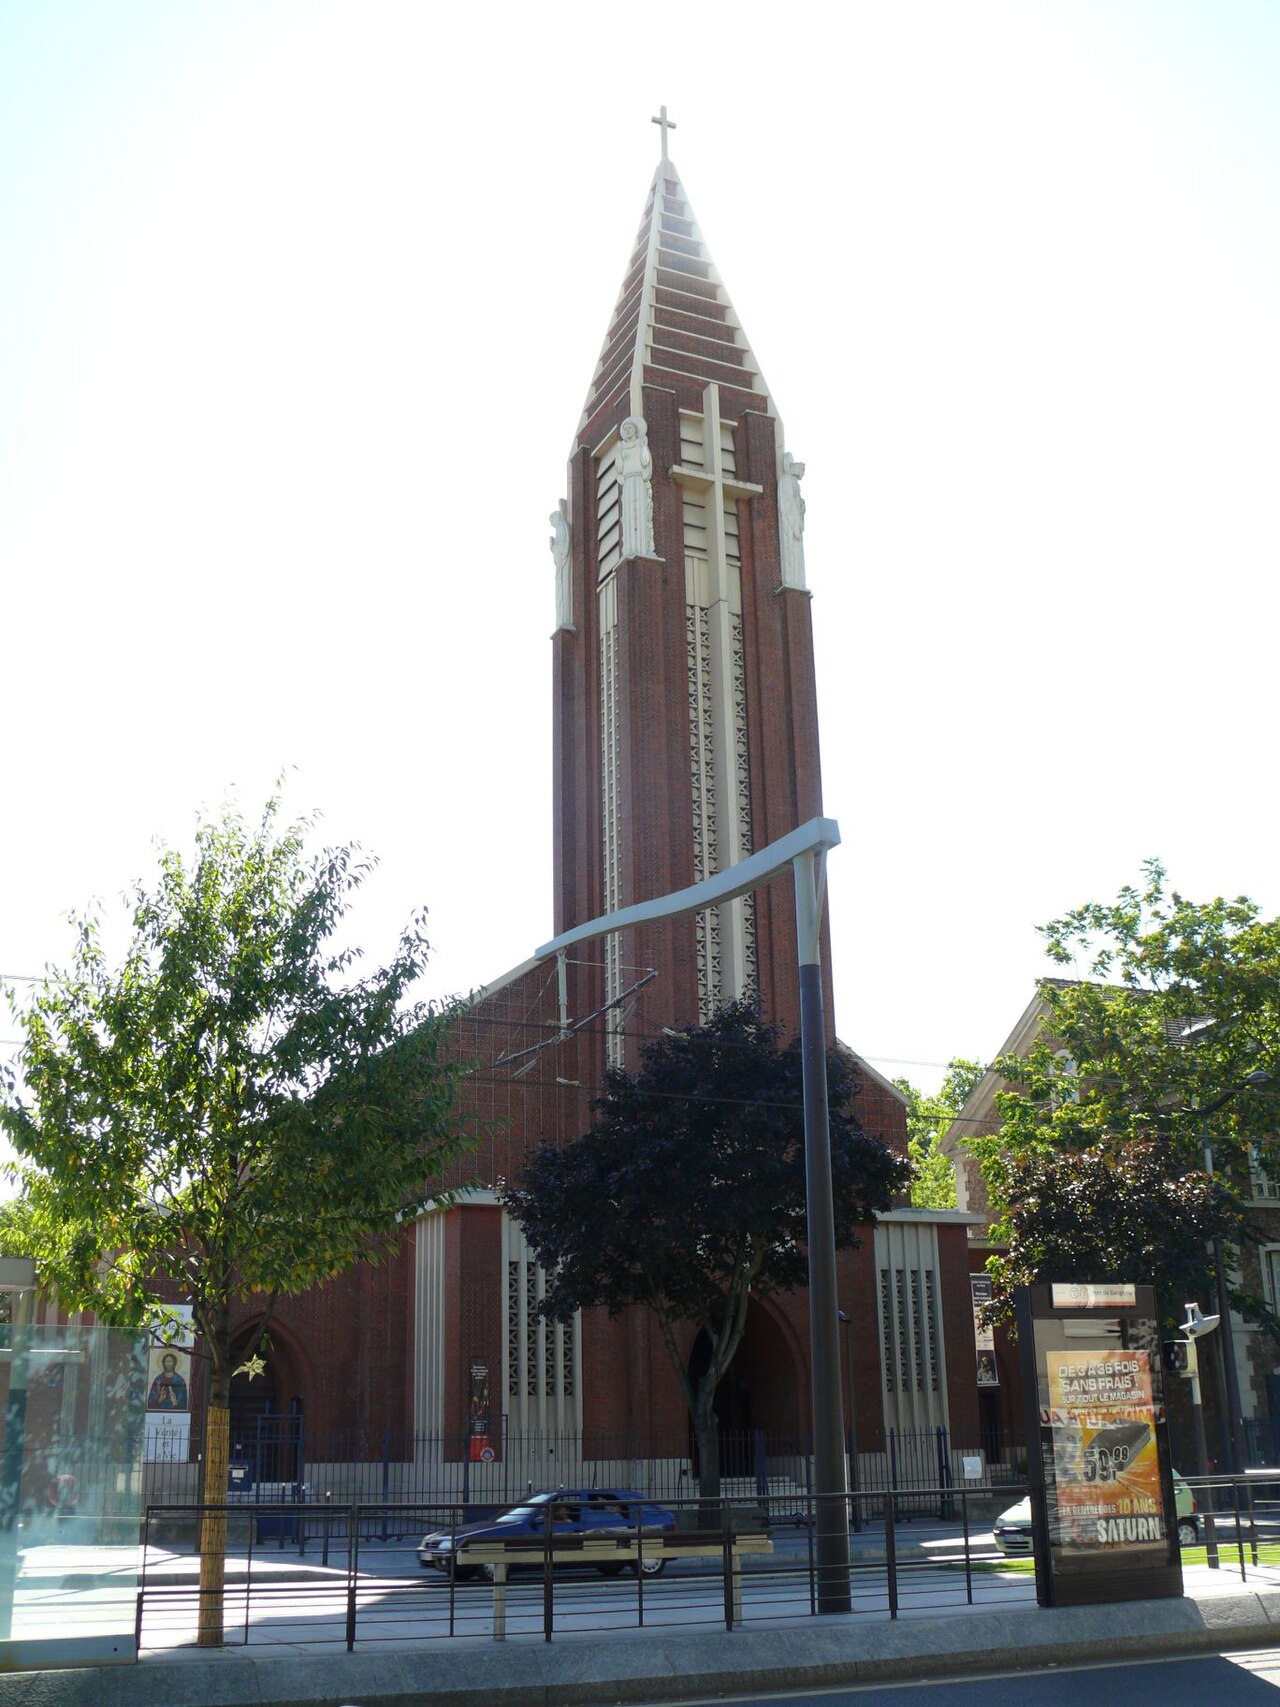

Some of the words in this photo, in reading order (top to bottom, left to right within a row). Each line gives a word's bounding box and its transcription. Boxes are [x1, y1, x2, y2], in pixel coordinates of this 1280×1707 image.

[1058, 1365, 1076, 1377] DE
[1077, 1364, 1085, 1376] 3
[1097, 1362, 1113, 1375] 36
[1114, 1360, 1140, 1374] FOIS
[1062, 1378, 1096, 1393] SANS
[1098, 1376, 1132, 1390] FRAIS
[1061, 1393, 1076, 1404] SUR
[1076, 1392, 1098, 1403] TOUT
[1099, 1391, 1109, 1402] LE
[1109, 1389, 1145, 1402] MAGASIN
[162, 1416, 172, 1425] La
[1117, 1498, 1131, 1514] 10
[1133, 1497, 1157, 1514] ANS
[1097, 1517, 1161, 1543] SATURN
